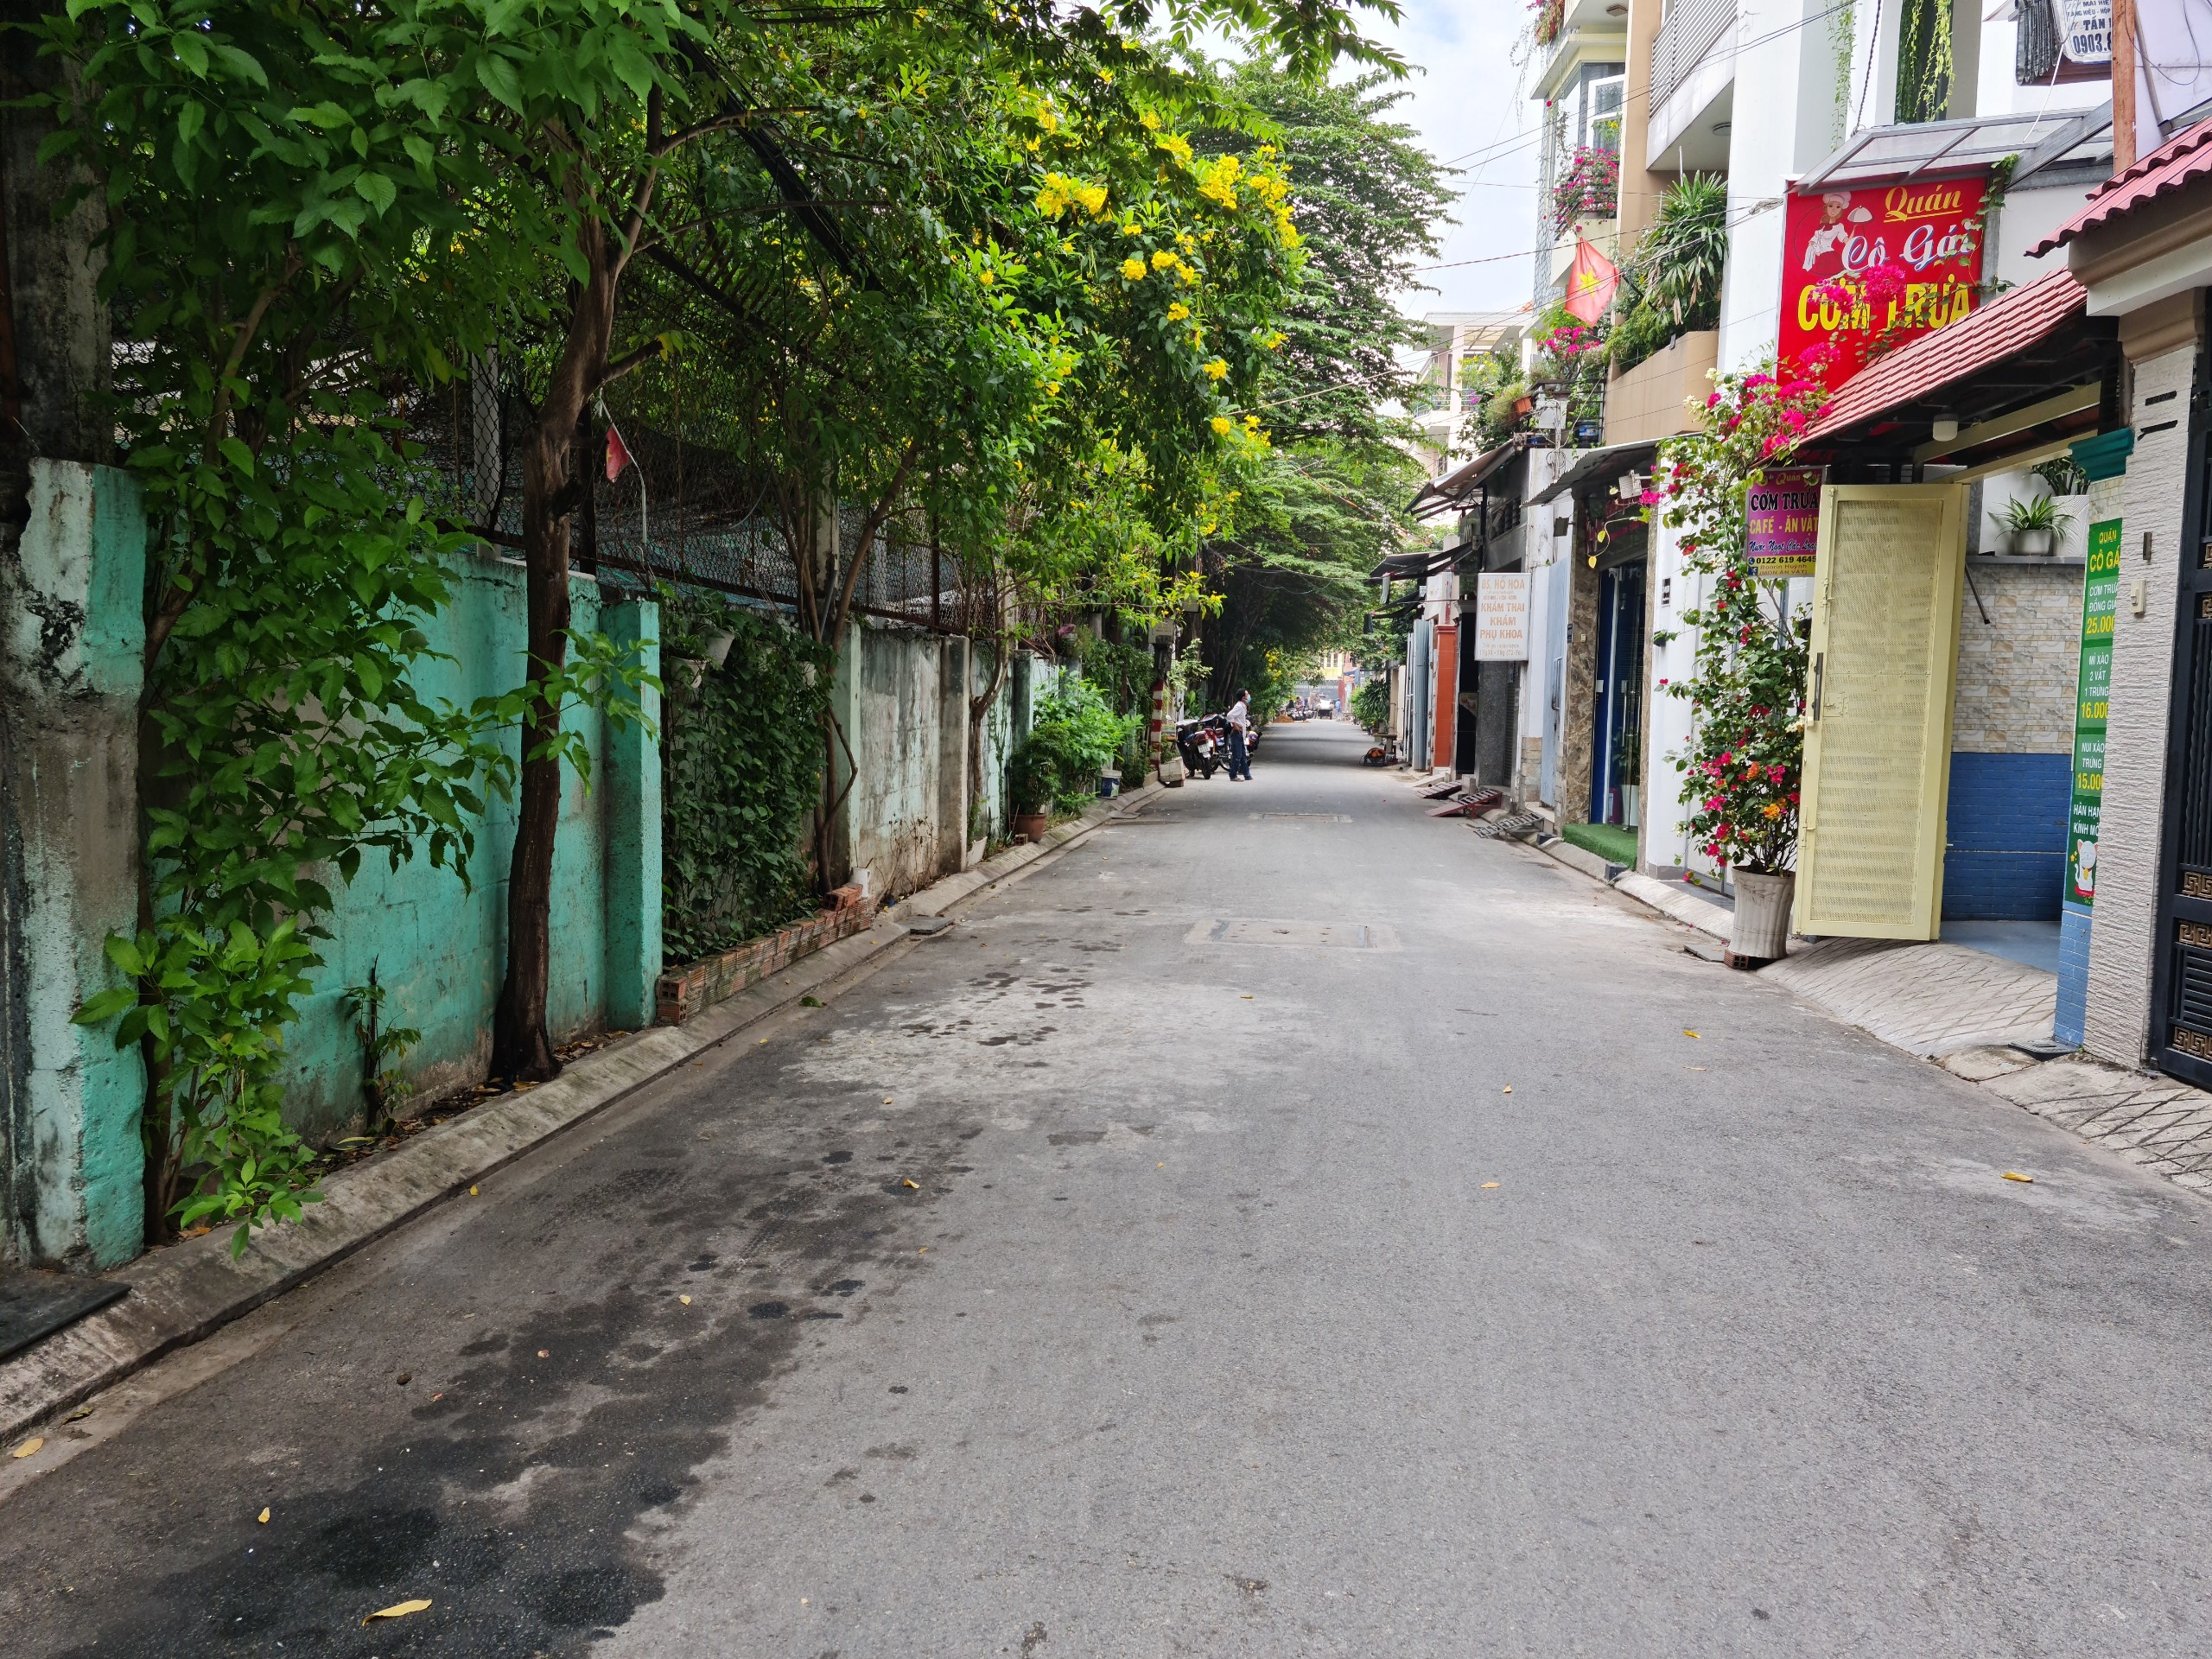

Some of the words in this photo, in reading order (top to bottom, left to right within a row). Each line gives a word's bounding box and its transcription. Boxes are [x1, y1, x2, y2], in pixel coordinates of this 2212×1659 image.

[1885, 184, 1963, 222] Quán
[1751, 490, 1779, 512] CƠM
[1782, 487, 1820, 511] TRƯA
[1750, 516, 1774, 535] CAFÉ
[2099, 528, 2117, 544] QUÁN
[2089, 549, 2104, 572] CÔ
[2089, 585, 2102, 597] CƠM
[1481, 601, 1504, 612] KHÁM
[1507, 602, 1525, 612] THAI
[1490, 614, 1516, 626] KHÁM
[1479, 629, 1497, 641] PHỤ
[1499, 629, 1523, 639] KHOA
[2089, 671, 2094, 682] 2
